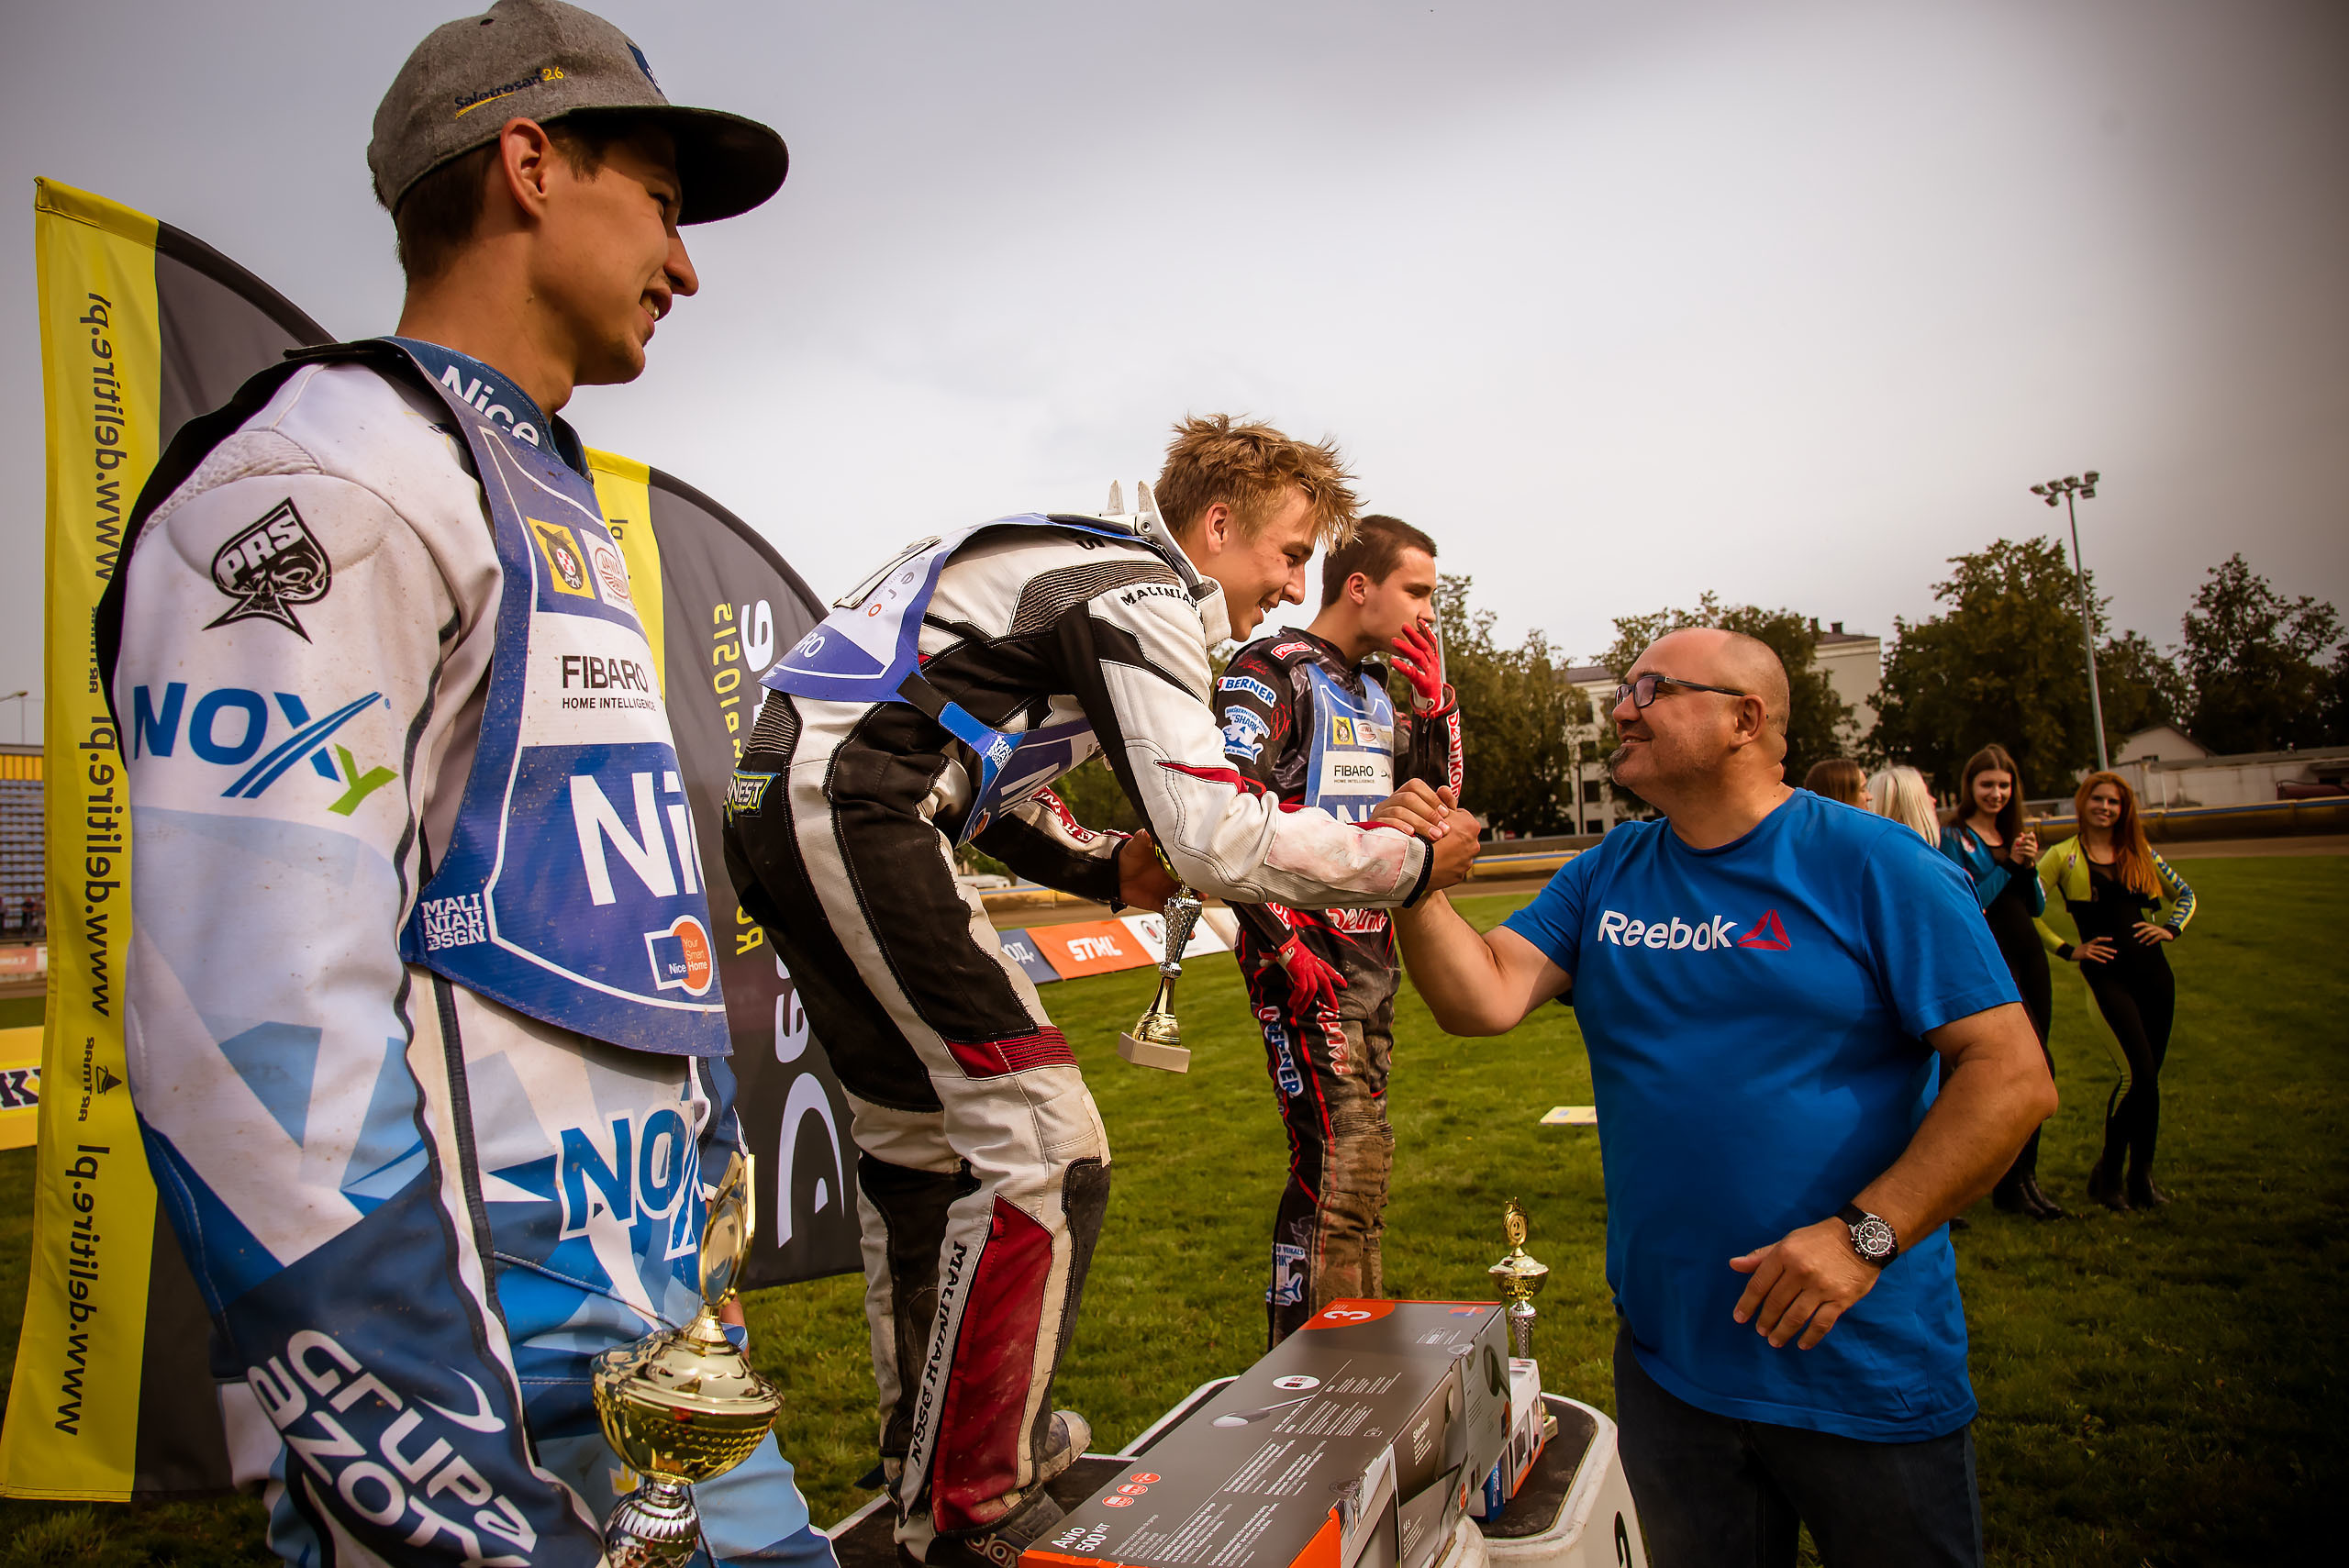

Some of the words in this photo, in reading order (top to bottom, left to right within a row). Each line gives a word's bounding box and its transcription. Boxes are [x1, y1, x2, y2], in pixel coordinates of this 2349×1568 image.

[562, 655, 649, 693] FIBARO
[1225, 678, 1275, 705] BERNER
[562, 697, 596, 709] HOME
[599, 697, 657, 712] INTELLIGENCE
[1334, 764, 1374, 777] FIBARO
[570, 771, 706, 906] Ni
[1598, 910, 1738, 951] Reebok
[683, 938, 698, 950] Your
[685, 949, 705, 961] Smart
[1066, 936, 1123, 962] STIHL
[669, 962, 686, 975] Nice
[688, 960, 708, 973] Home
[1051, 1525, 1085, 1550] Avio
